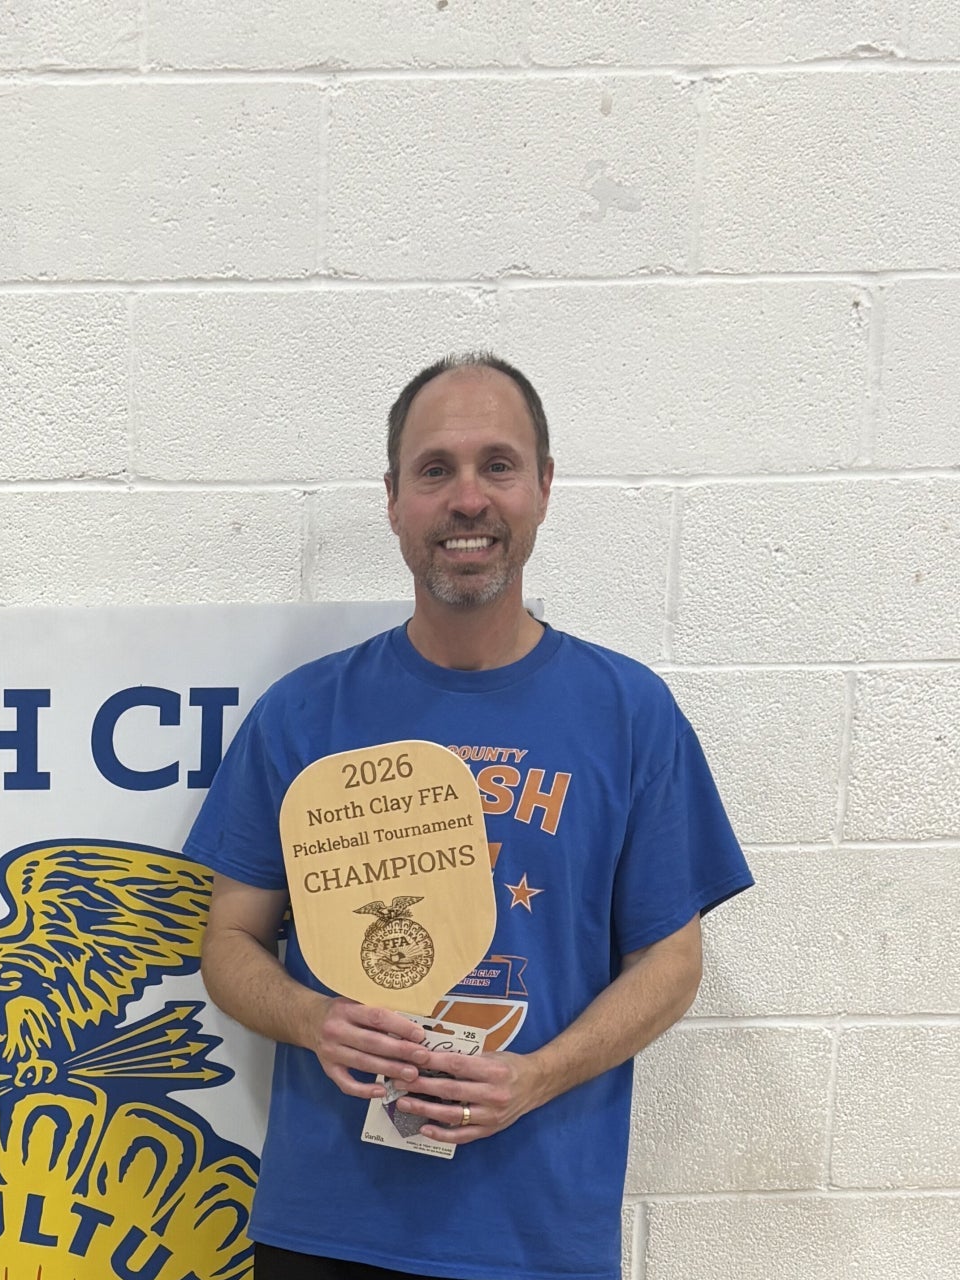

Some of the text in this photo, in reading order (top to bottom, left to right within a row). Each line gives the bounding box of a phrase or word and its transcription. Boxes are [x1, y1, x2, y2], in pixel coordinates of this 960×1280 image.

[90, 686, 239, 791] CL
[341, 753, 413, 789] 2026
[307, 784, 459, 827] North Clay FFA
[477, 764, 572, 836] SH
[292, 814, 474, 858] Pickleball Tournament
[304, 844, 476, 894] CHAMPIONS
[382, 936, 411, 951] FFA
[458, 977, 491, 986] NDIANS
[477, 969, 501, 977] CLAY
[463, 1030, 476, 1040] $25
